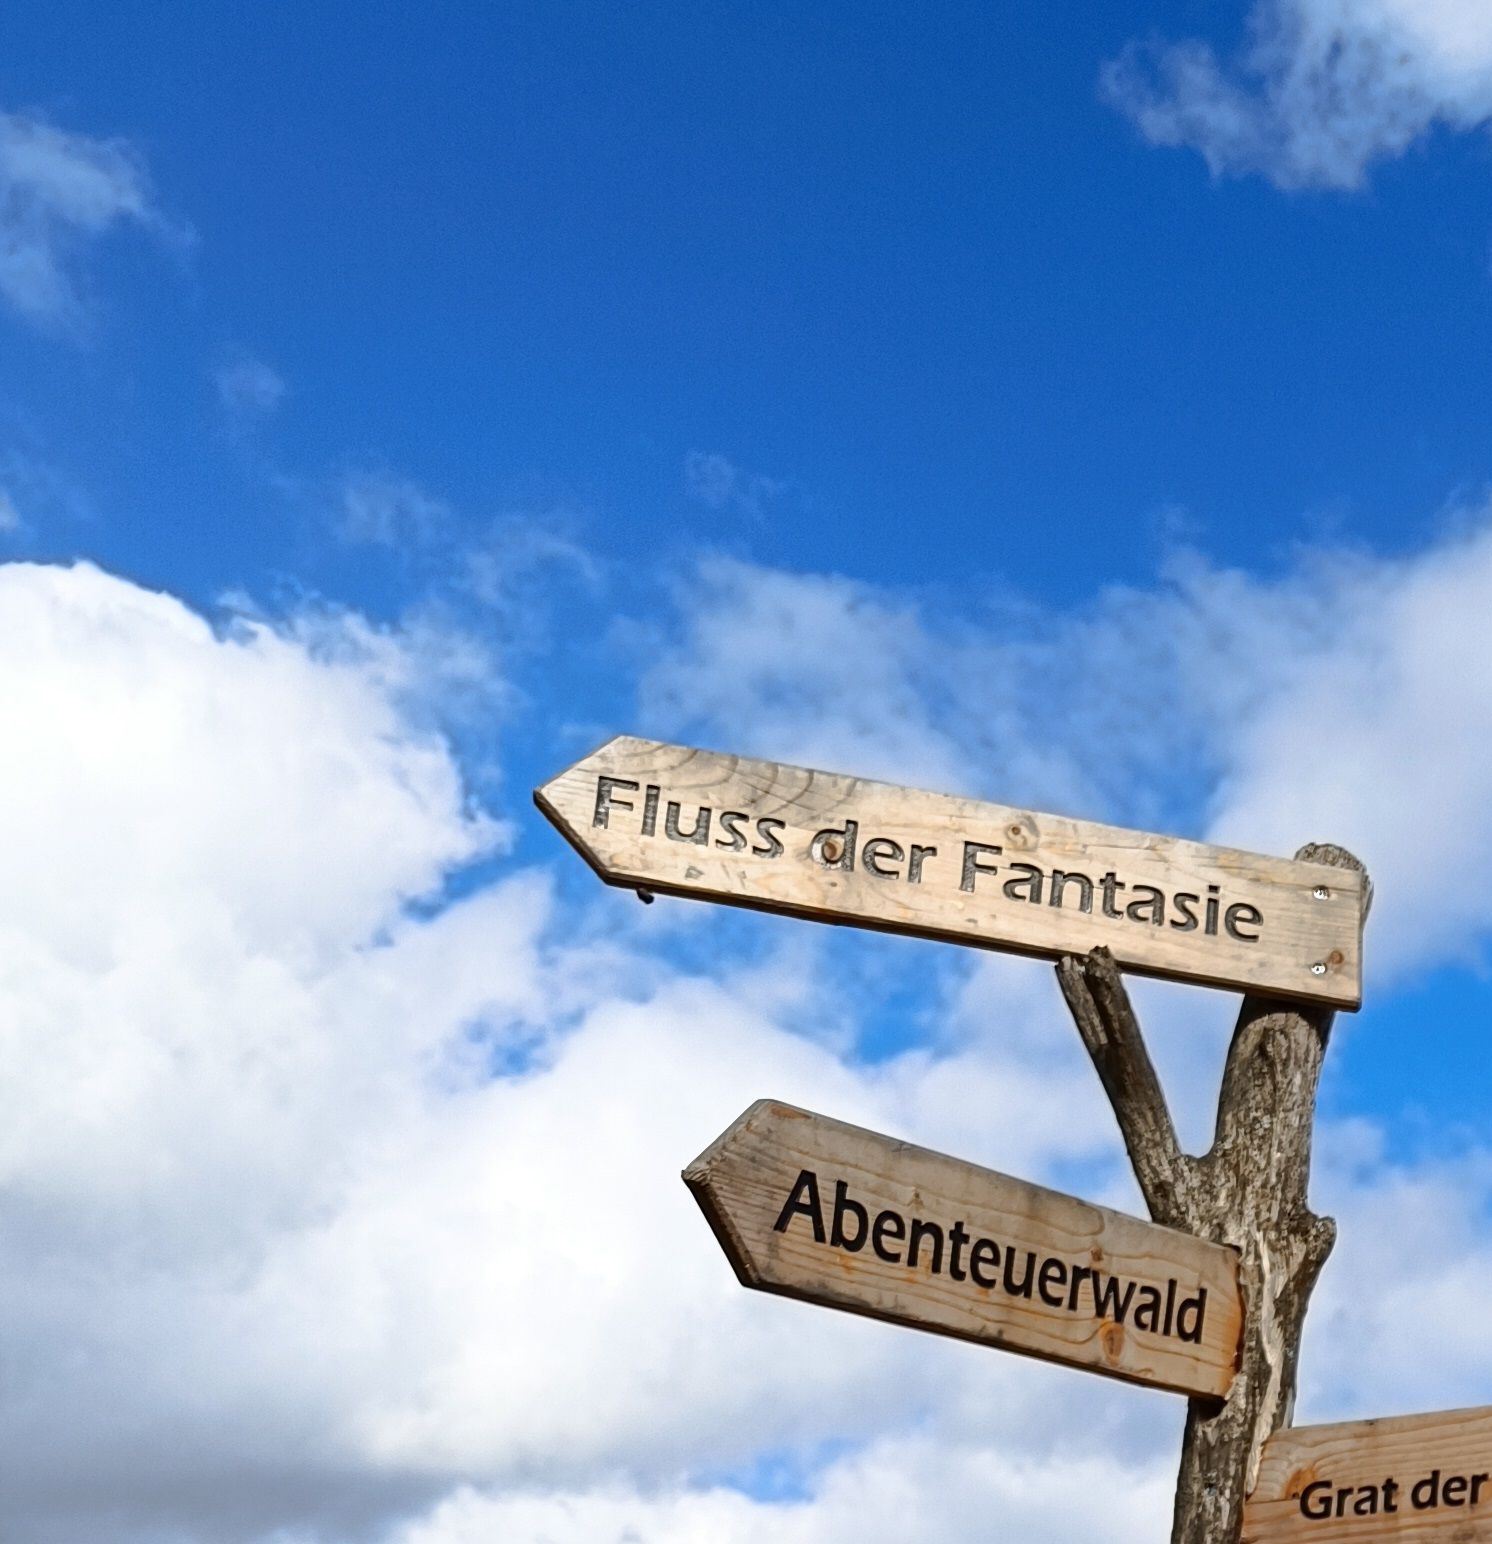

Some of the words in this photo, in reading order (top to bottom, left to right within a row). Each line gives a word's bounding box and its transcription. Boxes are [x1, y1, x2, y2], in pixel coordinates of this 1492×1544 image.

[592, 775, 786, 860] Fluss
[811, 819, 938, 885] der
[958, 841, 1265, 944] Fantasie
[773, 1169, 1207, 1344] Abenteuerwald
[1299, 1476, 1398, 1520] Grat
[1411, 1468, 1489, 1510] der
